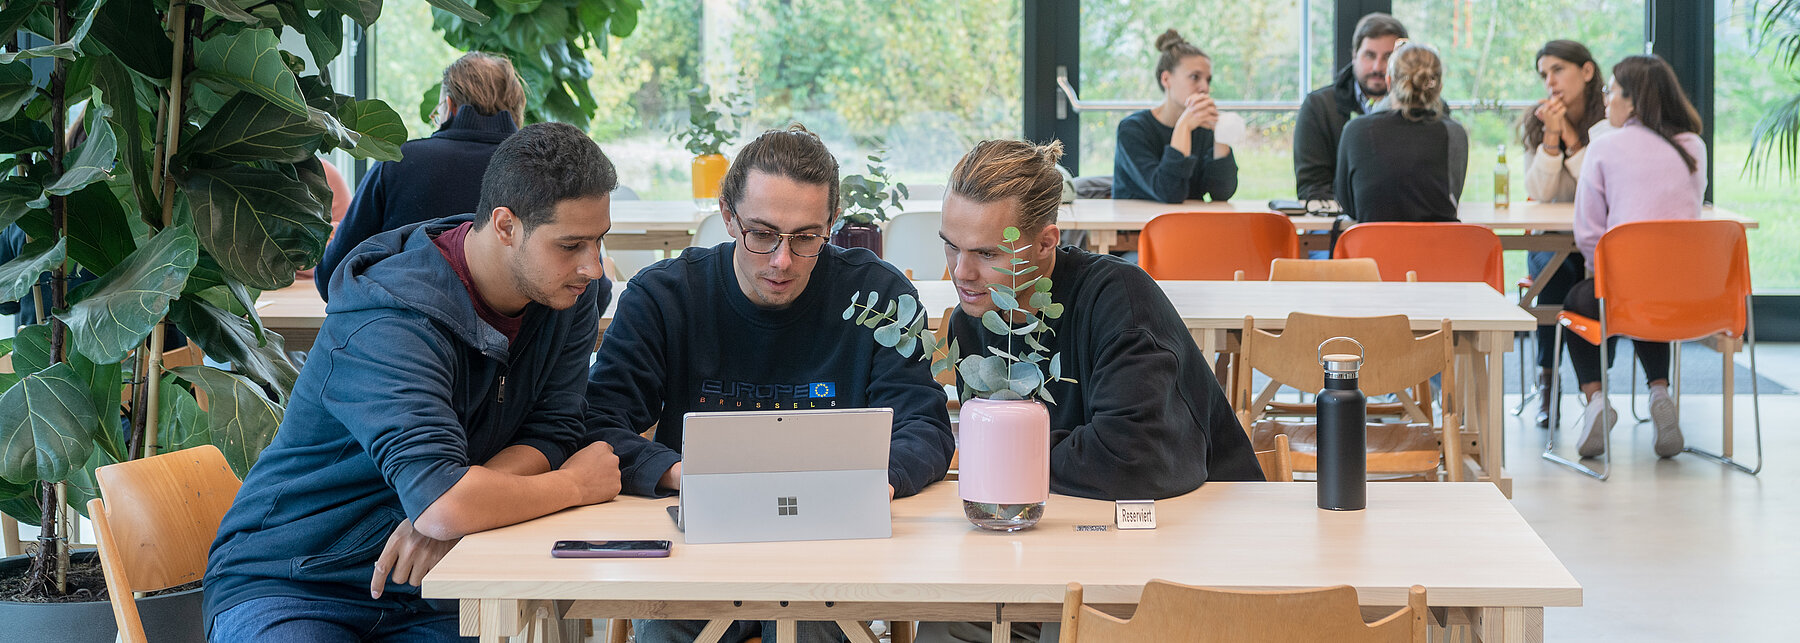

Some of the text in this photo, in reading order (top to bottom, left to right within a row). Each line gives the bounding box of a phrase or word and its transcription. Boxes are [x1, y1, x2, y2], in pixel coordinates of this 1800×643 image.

[702, 379, 809, 400] EUROPE
[700, 396, 836, 409] BRUSSELS
[1122, 508, 1152, 522] Reserviert
